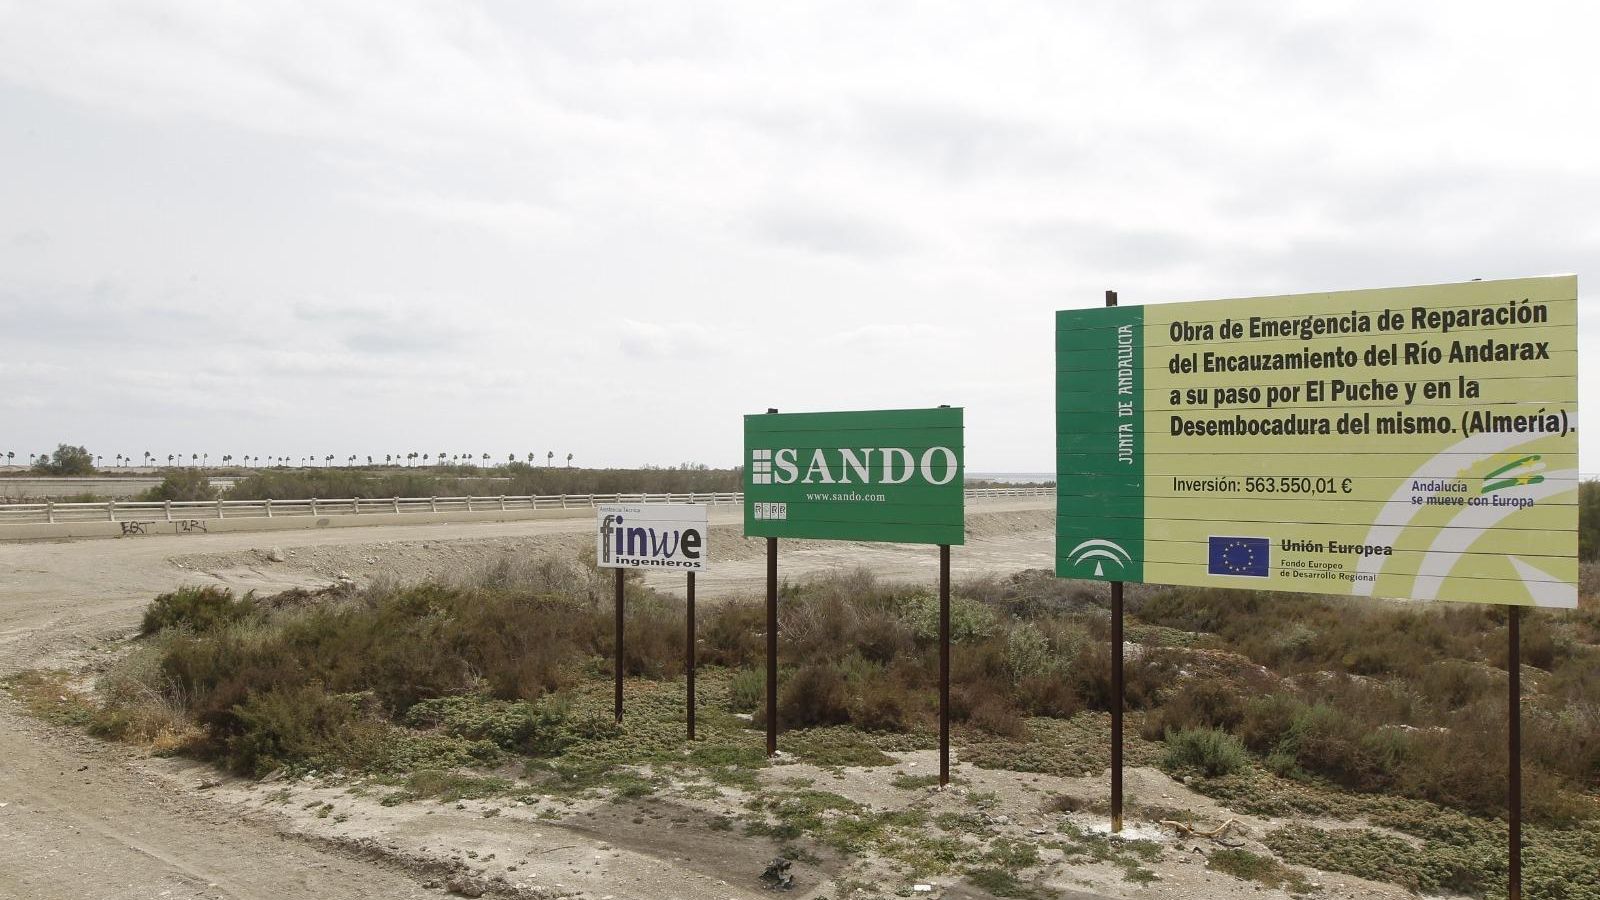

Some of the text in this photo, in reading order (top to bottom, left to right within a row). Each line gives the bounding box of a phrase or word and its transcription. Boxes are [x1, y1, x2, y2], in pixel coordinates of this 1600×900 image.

[1170, 298, 1548, 342] Obra de Emergencia de Reparación
[1169, 339, 1550, 374] del Encauzamiento del Río Andarax
[1169, 375, 1480, 408] a su paso por El Puche y en la
[1118, 400, 1134, 418] DE
[1170, 408, 1576, 438] Desembocadura del mismo. (Almería).
[1118, 423, 1134, 465] JUNTA
[774, 446, 958, 485] SANDO
[1173, 476, 1353, 496] Inversión: 563.550,01 €
[1411, 480, 1468, 493] Andalucía
[806, 491, 886, 502] www.sando.com
[1411, 494, 1534, 510] se mueve con Europa
[600, 514, 702, 564] finwe
[1281, 538, 1393, 556] Unión Europea
[615, 556, 701, 568] ingenieros
[1281, 559, 1343, 571] Fondo Europeo
[1280, 569, 1377, 583] de Desarrollo Regional
